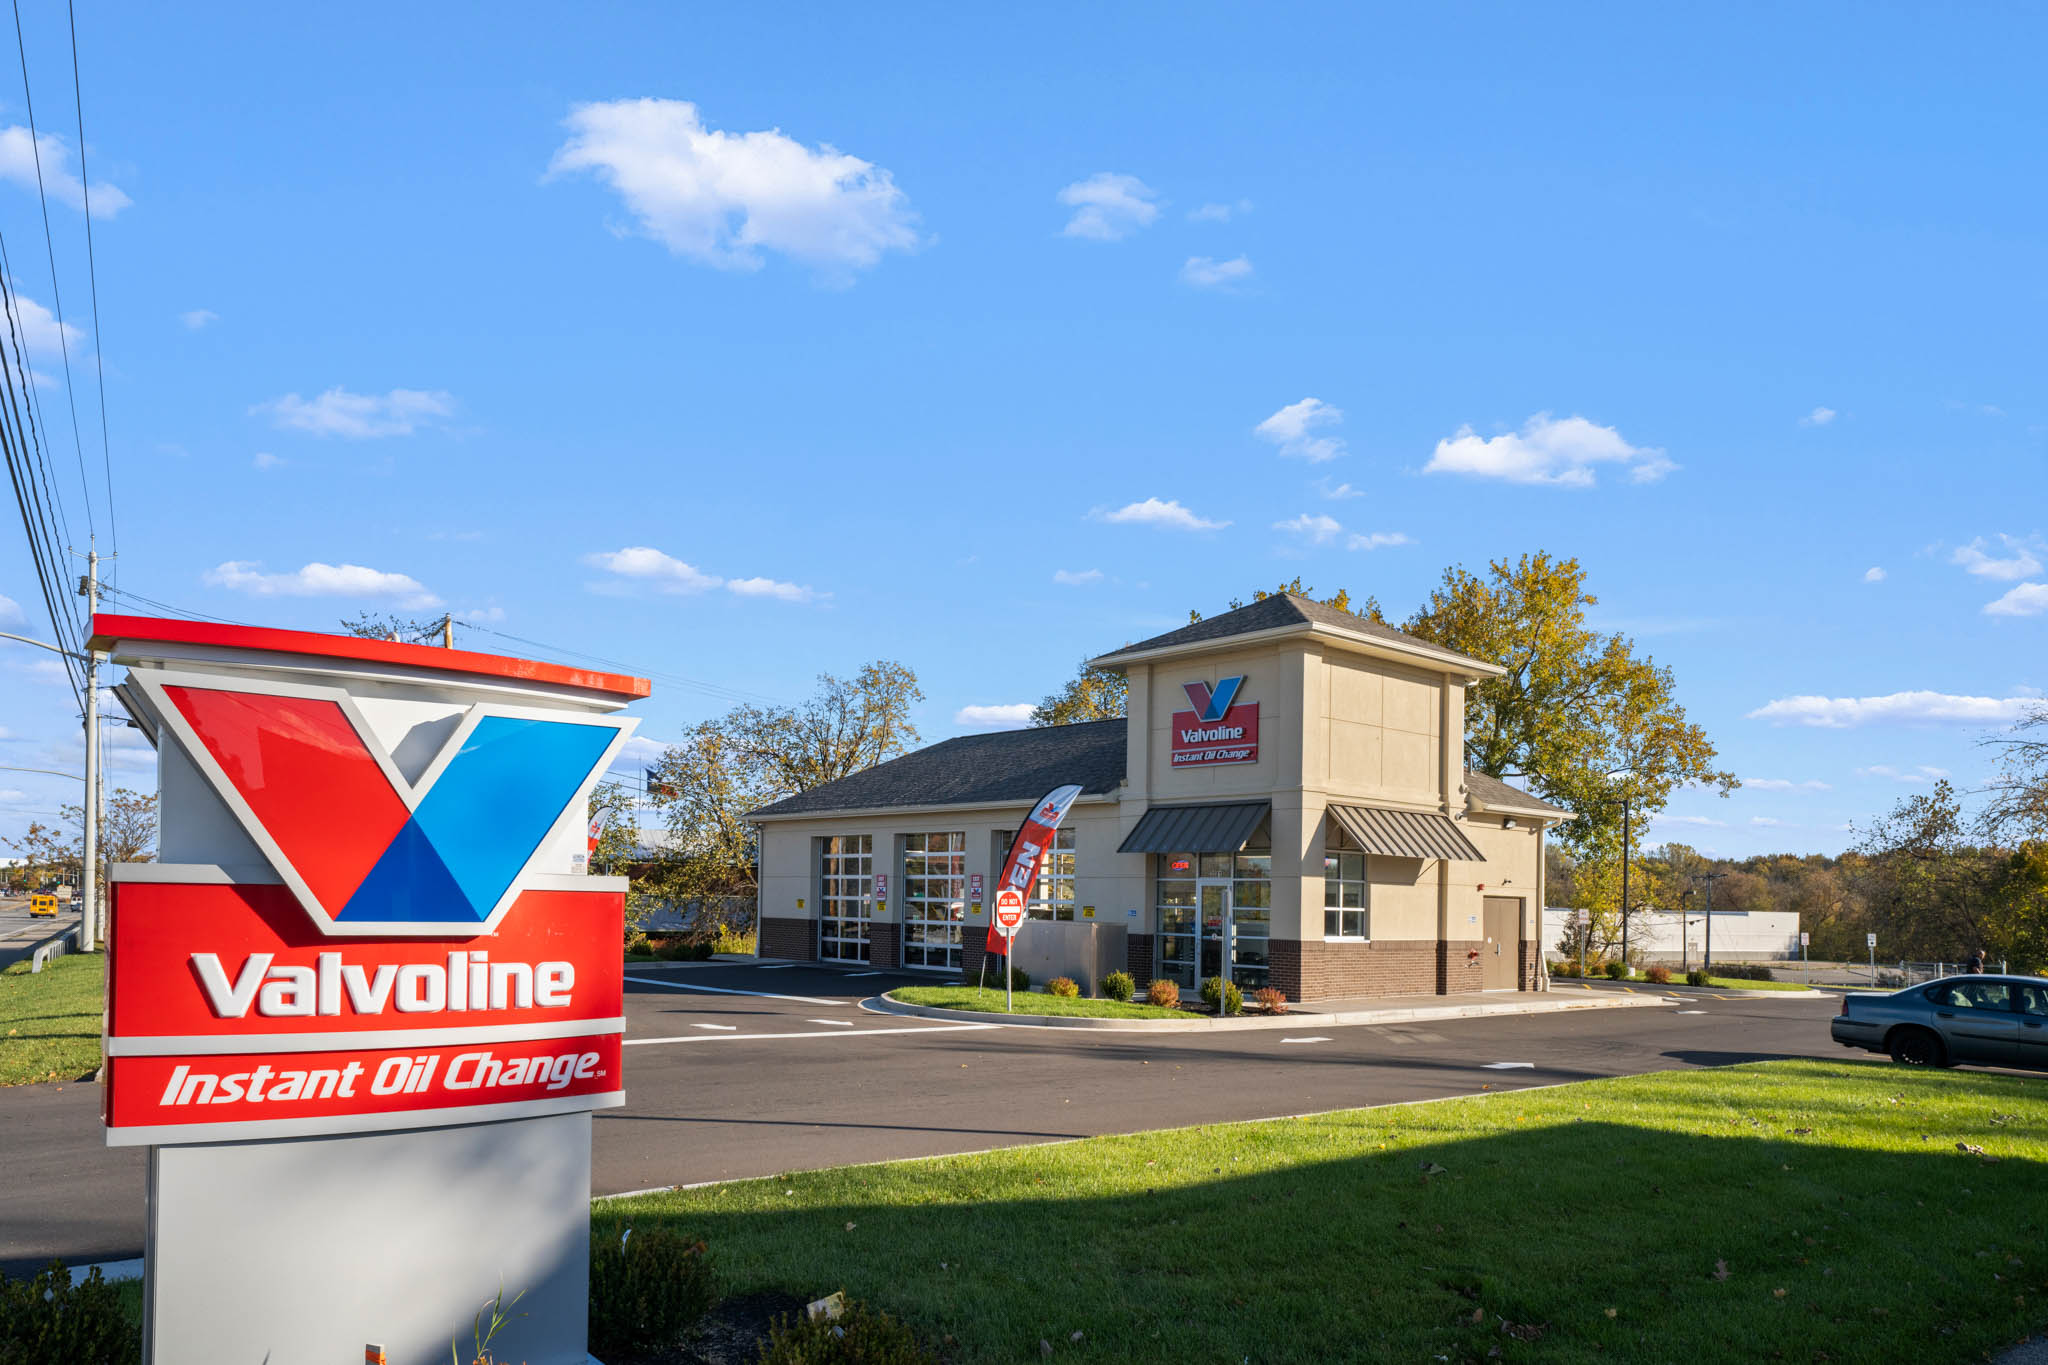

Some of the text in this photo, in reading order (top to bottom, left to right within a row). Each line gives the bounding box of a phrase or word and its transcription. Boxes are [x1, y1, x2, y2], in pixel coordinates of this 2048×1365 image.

[1173, 749, 1250, 763] Instant Oil Change
[1181, 725, 1243, 743] Valvoline
[1005, 841, 1041, 891] EN
[190, 951, 575, 1018] Valvoline
[159, 1061, 365, 1106] Instant
[370, 1055, 441, 1096] Oil
[443, 1052, 600, 1091] Change
